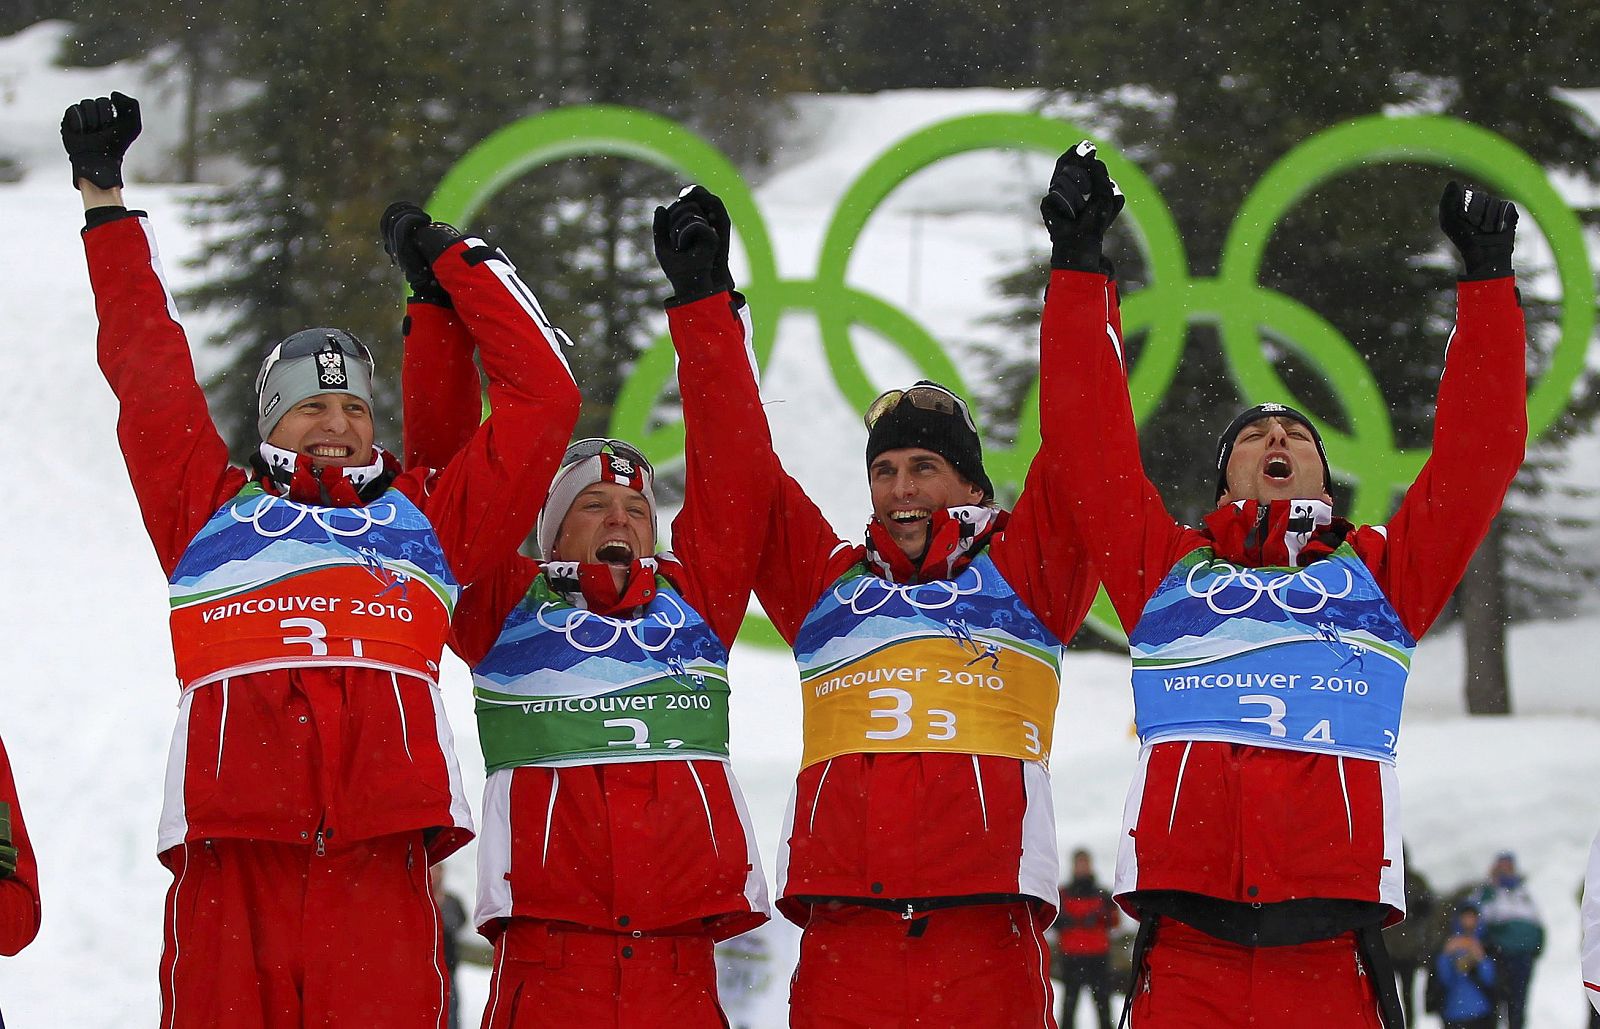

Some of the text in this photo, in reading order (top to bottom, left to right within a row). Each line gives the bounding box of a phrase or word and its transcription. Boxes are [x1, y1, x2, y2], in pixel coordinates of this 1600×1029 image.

[202, 595, 413, 624] vancouver 2010
[279, 617, 328, 656] 3
[815, 666, 1004, 698] vancouver 2010
[1163, 672, 1369, 696] vancouver 2010
[521, 694, 711, 715] vancouver 2010
[865, 687, 957, 741] 3 3
[1238, 694, 1336, 745] 3 4
[1022, 720, 1041, 756] 3
